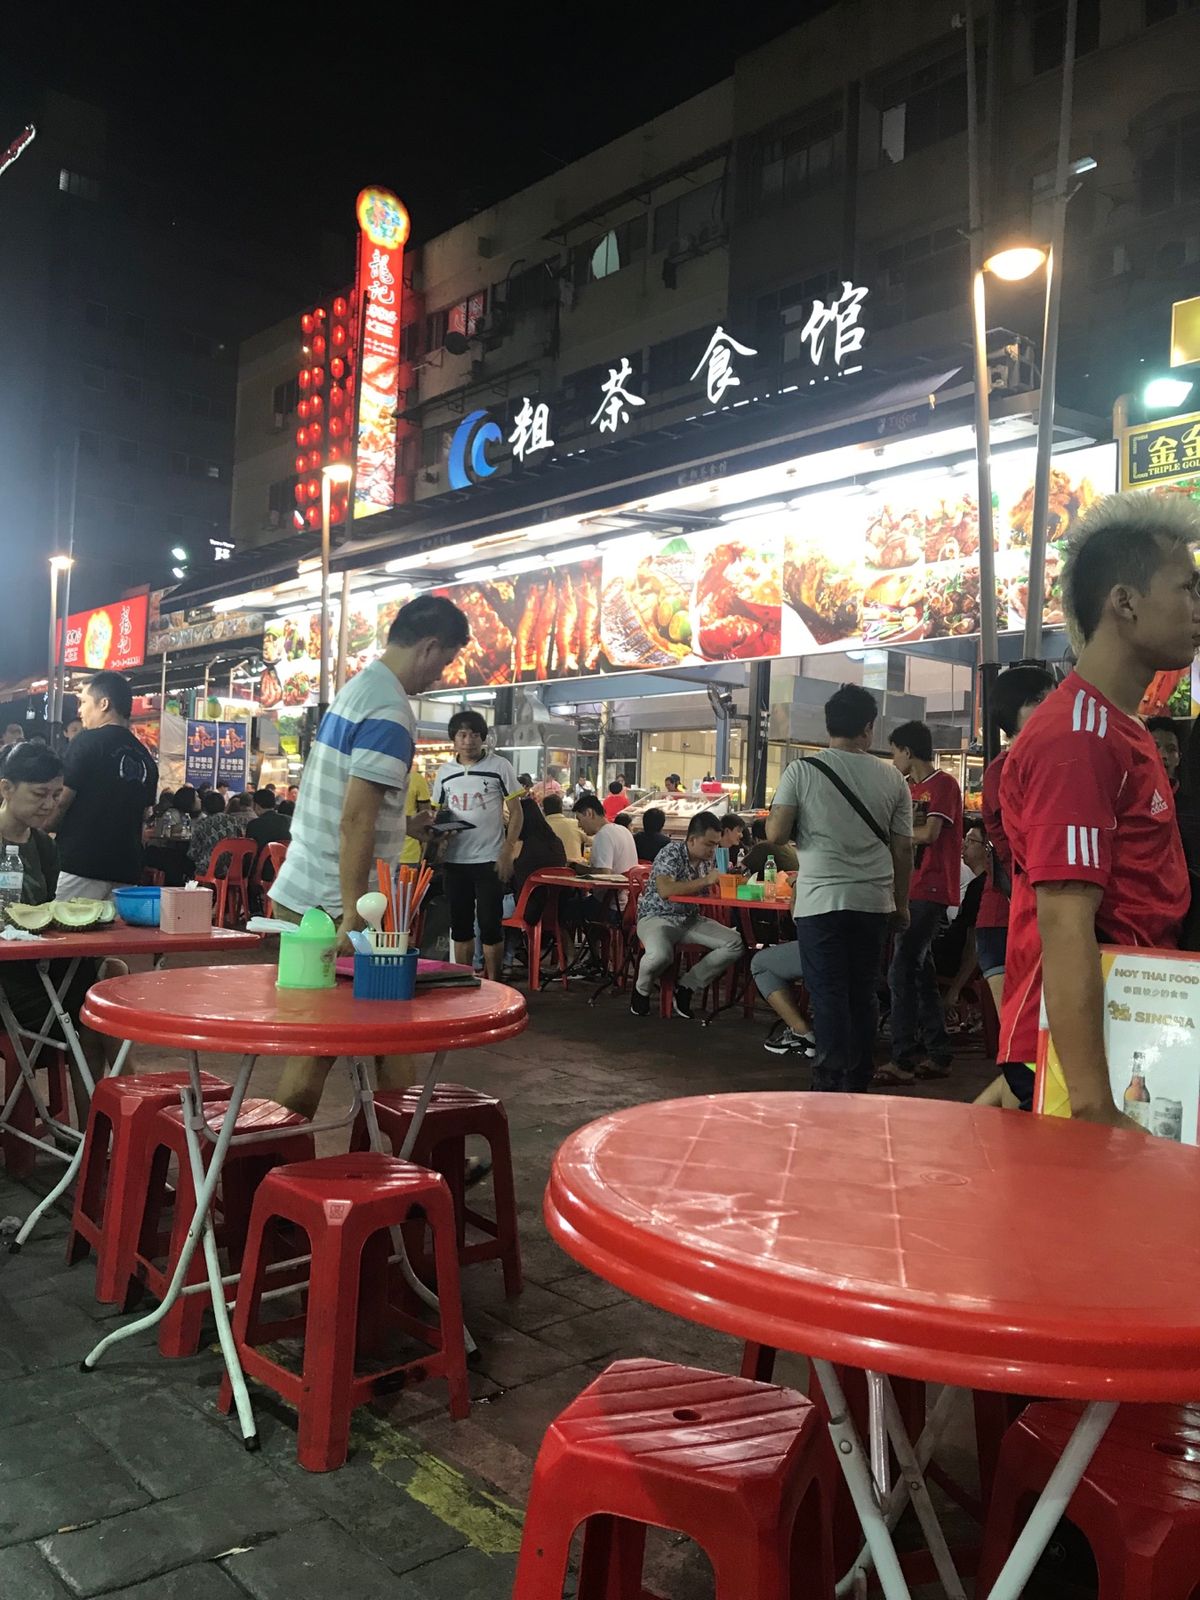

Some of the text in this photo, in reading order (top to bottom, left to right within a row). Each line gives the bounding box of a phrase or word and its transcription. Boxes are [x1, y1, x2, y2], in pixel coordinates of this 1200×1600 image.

[1147, 462, 1181, 476] TRIPLE
[1115, 968, 1199, 984] NOY THAI FOOD
